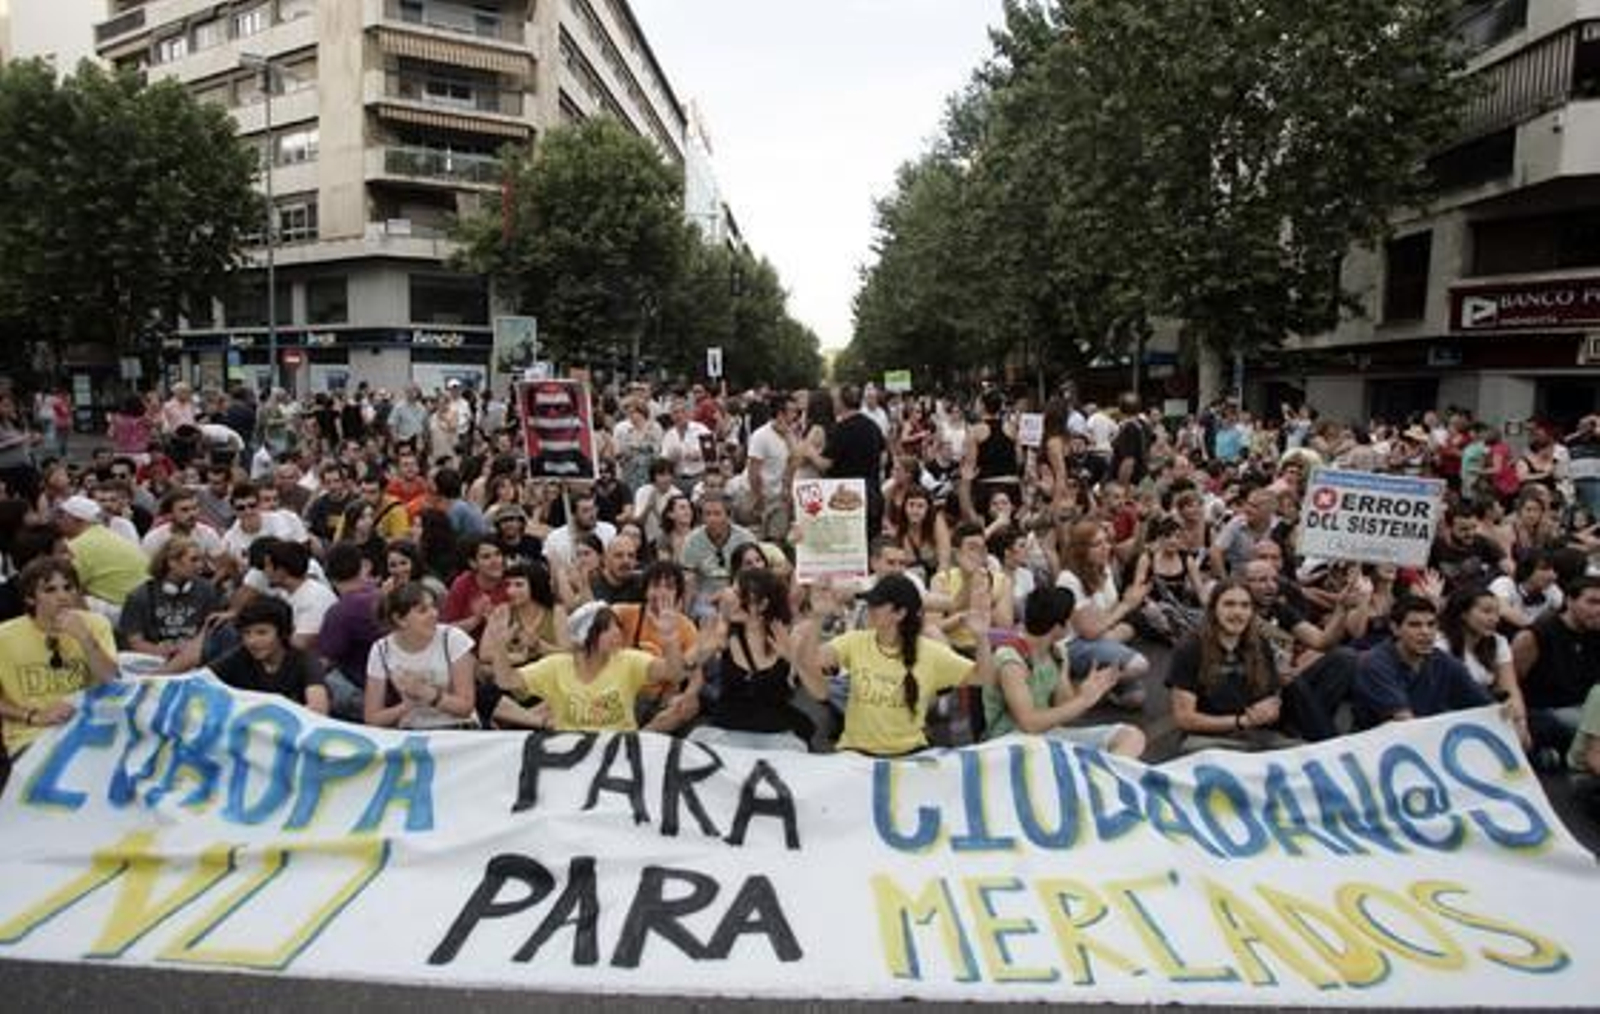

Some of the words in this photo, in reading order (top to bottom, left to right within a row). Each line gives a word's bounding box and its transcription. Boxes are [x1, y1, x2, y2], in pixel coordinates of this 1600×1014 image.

[1501, 290, 1574, 309] BANCO
[1341, 493, 1431, 519] ERROR
[1347, 516, 1429, 540] SISTEMA
[20, 675, 435, 831] EUROPA
[511, 731, 801, 850] PARA
[0, 830, 390, 971] NO
[427, 853, 803, 967] PARA
[868, 870, 1571, 990] MERCADOS
